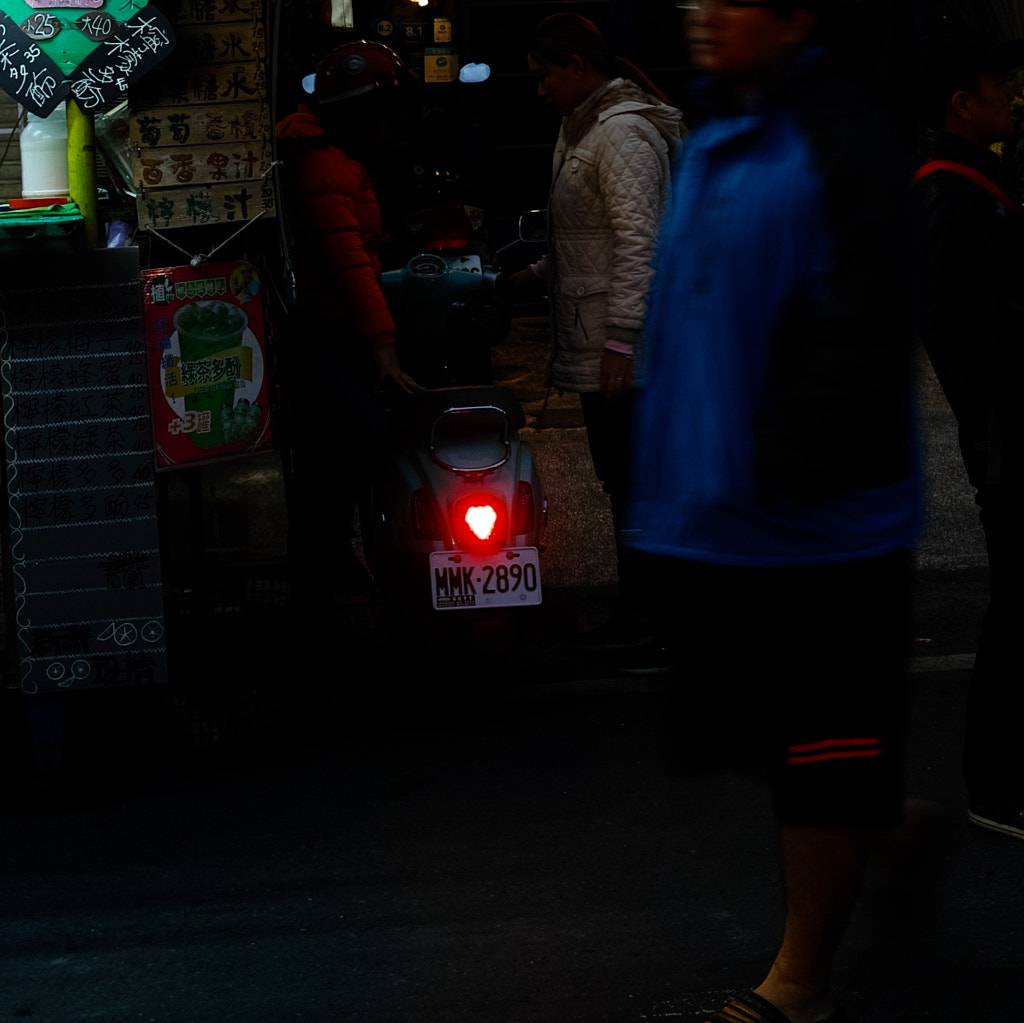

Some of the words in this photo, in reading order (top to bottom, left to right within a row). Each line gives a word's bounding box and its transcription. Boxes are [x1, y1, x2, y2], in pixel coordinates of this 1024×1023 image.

[23, 42, 41, 64] 35
[140, 150, 258, 185] 百香果汁
[181, 356, 241, 387] 綠茶多酚
